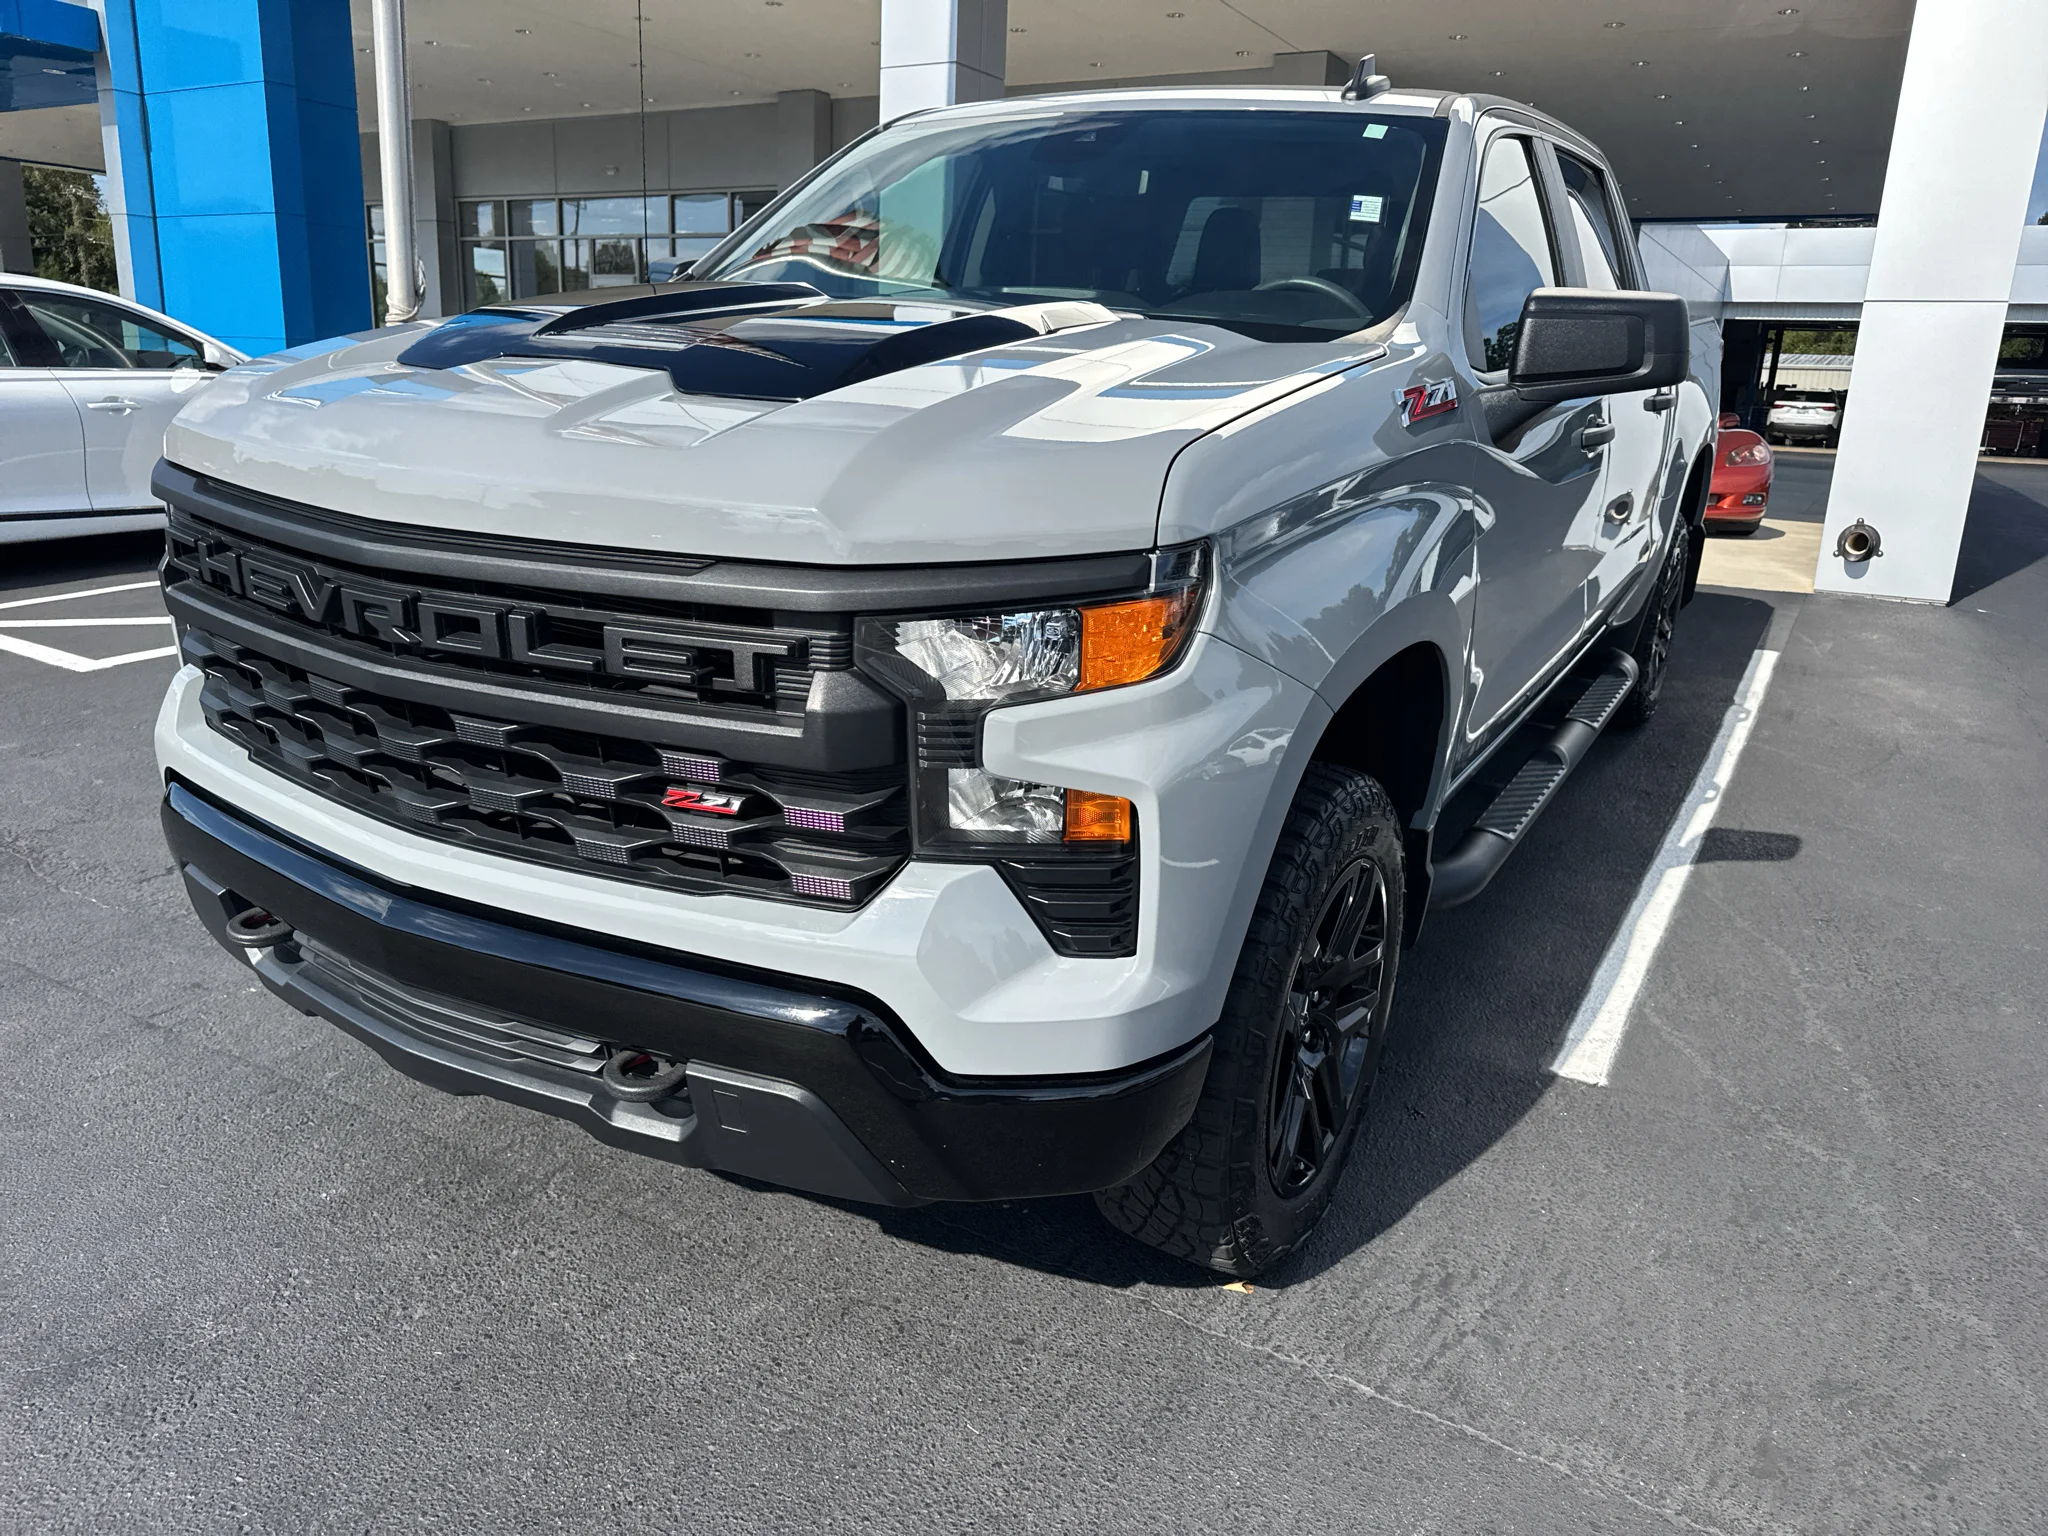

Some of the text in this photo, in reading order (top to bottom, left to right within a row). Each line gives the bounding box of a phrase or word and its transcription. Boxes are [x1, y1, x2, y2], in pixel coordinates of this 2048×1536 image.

[1392, 377, 1458, 427] Z71
[164, 525, 807, 696] CHEVROLET
[661, 787, 745, 815] Z71
